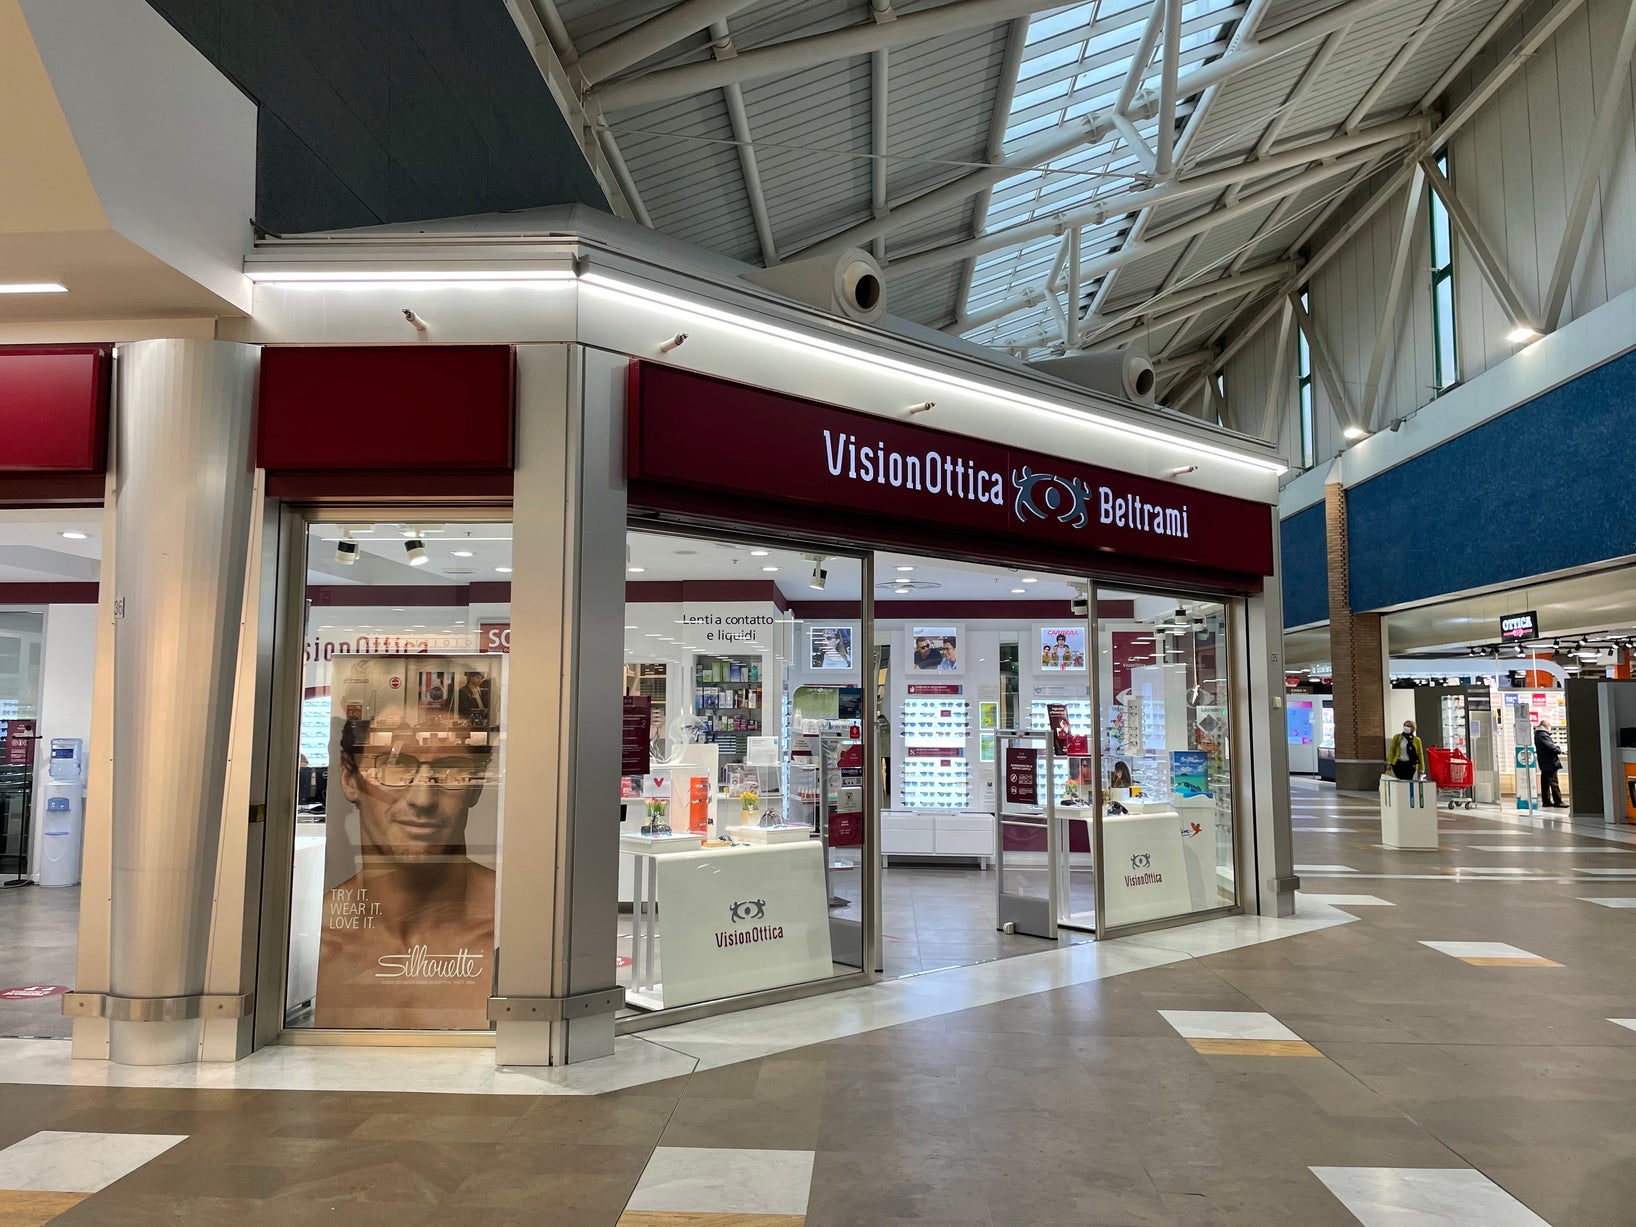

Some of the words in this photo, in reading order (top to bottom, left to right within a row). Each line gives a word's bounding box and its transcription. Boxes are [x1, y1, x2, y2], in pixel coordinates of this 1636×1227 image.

[823, 429, 1004, 506] VisionOttica
[1098, 486, 1189, 538] Beltrami
[683, 613, 713, 625] Lenti
[715, 616, 722, 625] a
[725, 615, 774, 625] contatto
[1502, 616, 1533, 631] OTTICA
[706, 632, 714, 641] e
[718, 630, 756, 643] liquidi
[1124, 872, 1163, 887] VisionOttica
[330, 888, 354, 901] TRY
[357, 888, 369, 901] IT.
[330, 902, 366, 915] WEAR
[371, 902, 383, 915] IT.
[329, 916, 359, 929] LOVE
[363, 916, 375, 929] IT.
[715, 925, 784, 948] VisionOttica
[374, 944, 484, 978] Silhouette
